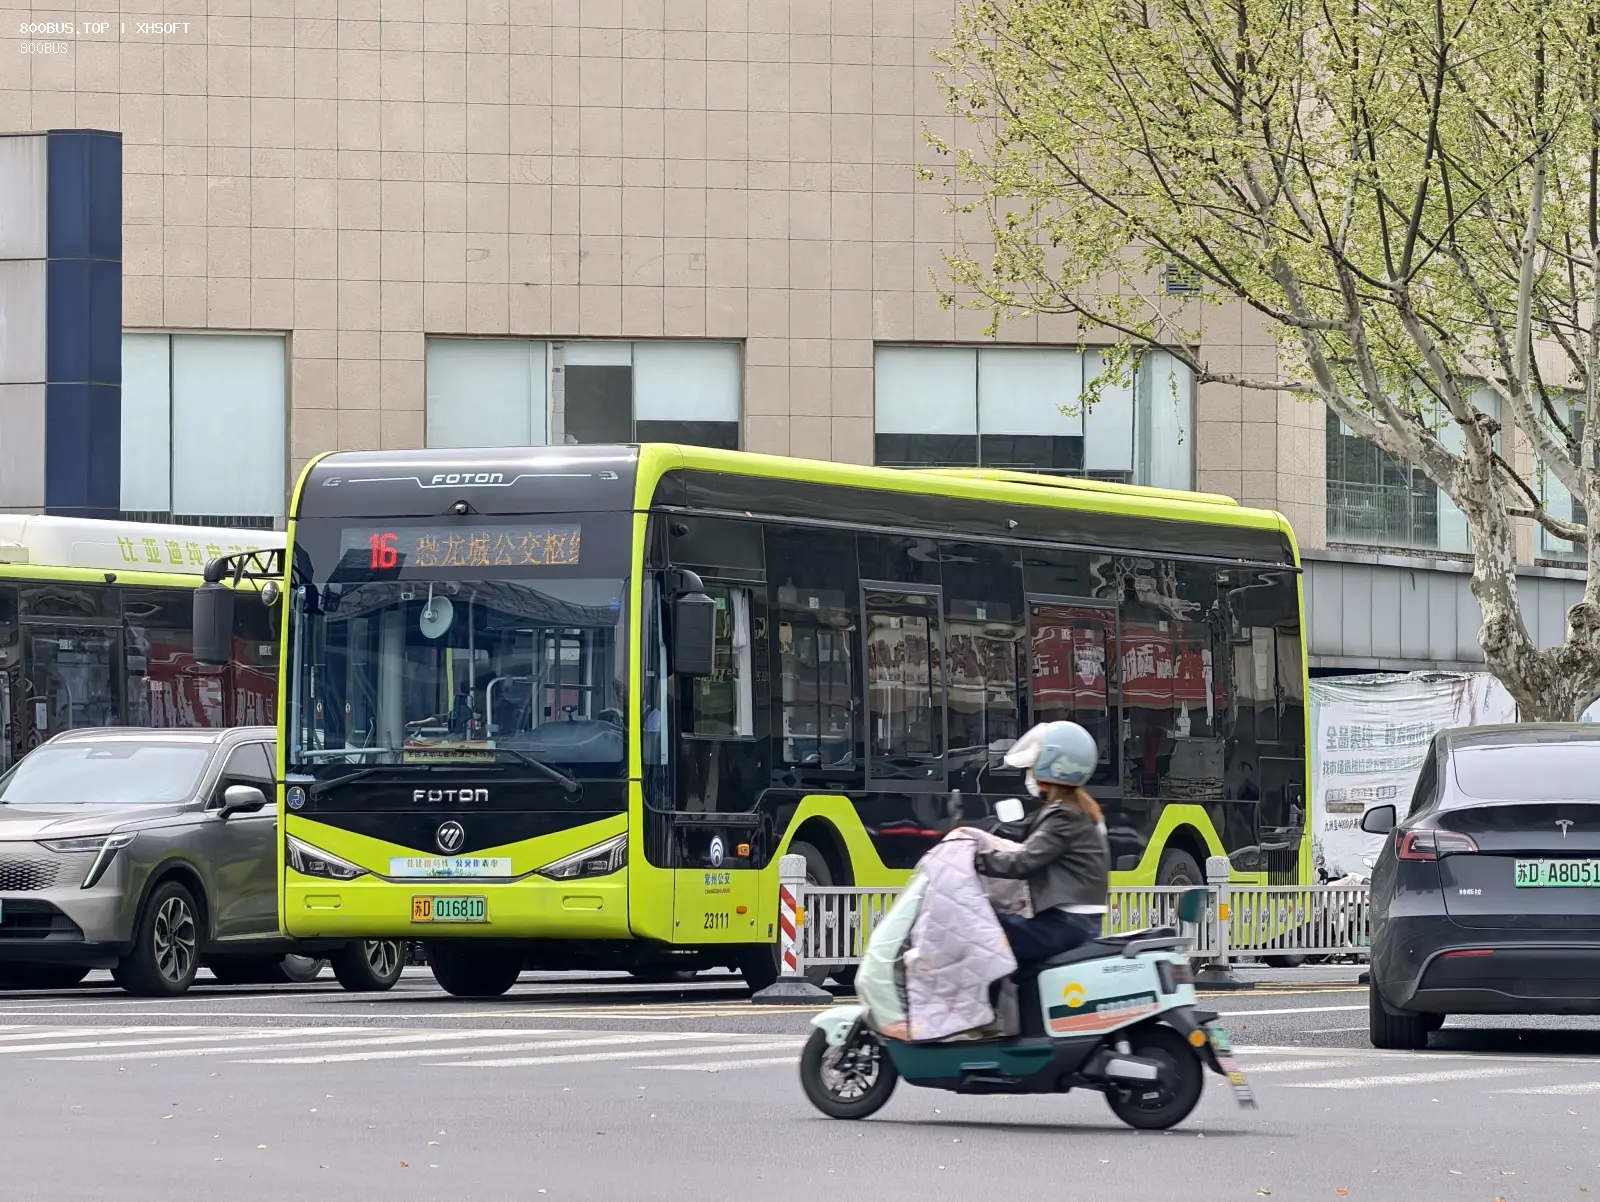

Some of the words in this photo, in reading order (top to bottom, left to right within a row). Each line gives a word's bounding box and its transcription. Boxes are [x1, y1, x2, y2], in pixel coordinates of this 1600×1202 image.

[431, 472, 504, 485] FOTON
[368, 532, 398, 571] 16
[413, 788, 489, 802] FOTON
[704, 872, 730, 886] 常州公交
[1517, 863, 1539, 883] 苏D
[414, 900, 431, 917] 苏D
[436, 900, 484, 917] 01681D
[704, 912, 729, 930] 23111
